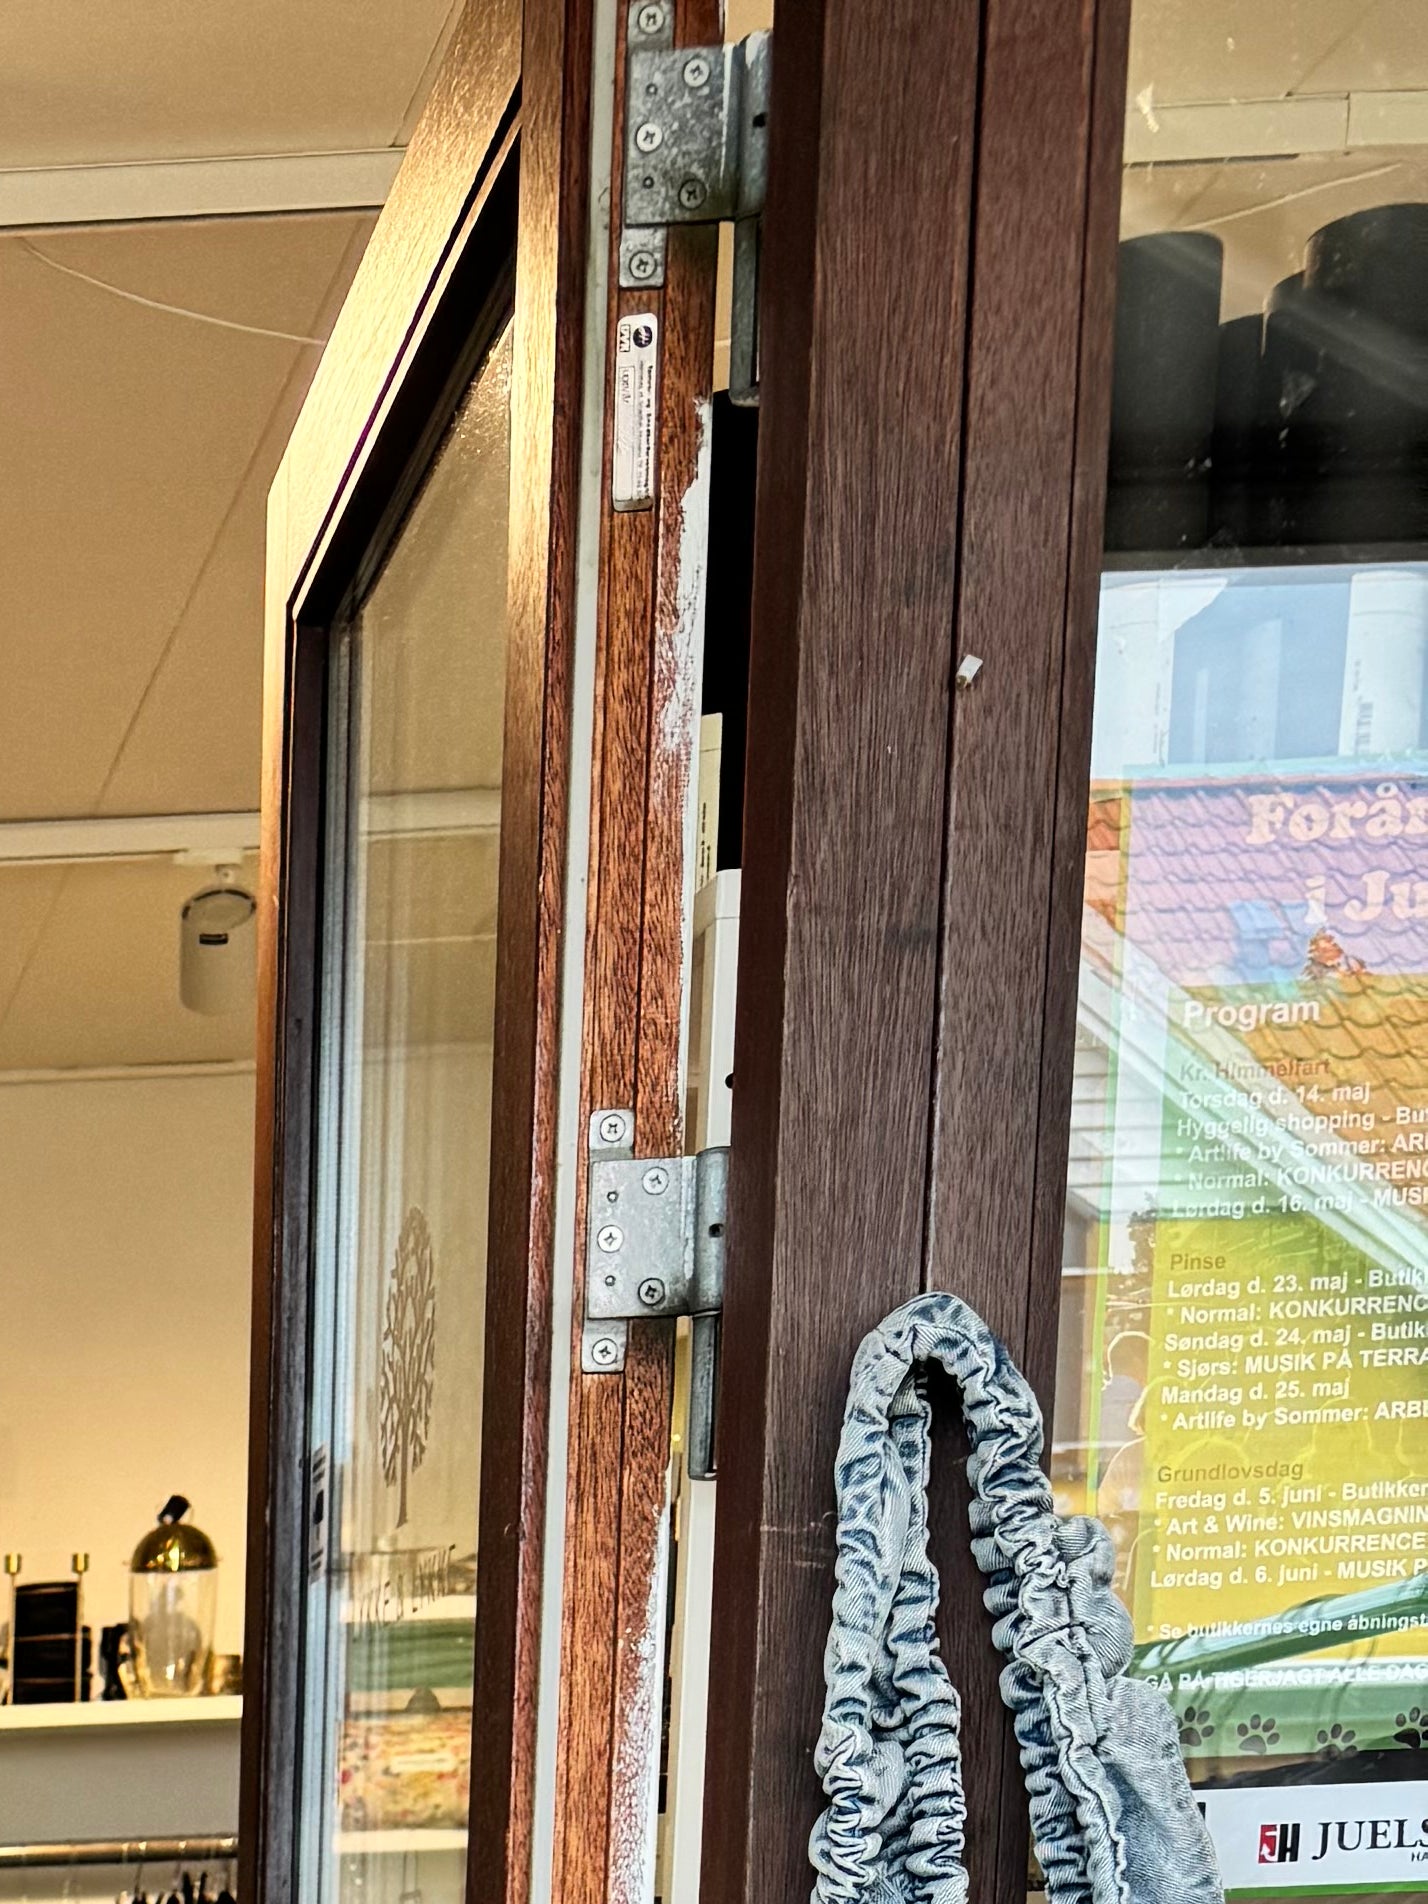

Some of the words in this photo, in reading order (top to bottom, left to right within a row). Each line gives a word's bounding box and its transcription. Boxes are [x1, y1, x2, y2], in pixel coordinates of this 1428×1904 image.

[1183, 1000, 1321, 1031] Program
[1215, 1058, 1331, 1080] Himmelfart
[1178, 1088, 1262, 1110] Torsdag
[1268, 1085, 1288, 1104] d.
[1296, 1085, 1325, 1104] 14.
[1332, 1082, 1370, 1104] maj
[1176, 1114, 1268, 1139] Hyggelig
[1275, 1110, 1375, 1134] shopping
[1257, 1142, 1284, 1164] by
[1290, 1138, 1386, 1158] Sommer:
[1188, 1170, 1269, 1191] Normal:
[1172, 1198, 1245, 1220] Lørdag
[1314, 1191, 1354, 1214] maj
[1170, 1252, 1226, 1271] Pinse
[1168, 1278, 1240, 1299] Lørdag
[1247, 1275, 1265, 1295] d.
[1272, 1275, 1304, 1294] 23.
[1310, 1271, 1348, 1294] maj
[1180, 1305, 1262, 1325] Normal:
[1164, 1332, 1244, 1353] Søndag
[1249, 1329, 1269, 1348] d.
[1275, 1328, 1307, 1347] 24.
[1313, 1324, 1351, 1347] maj
[1176, 1357, 1238, 1380] Sjørs:
[1244, 1353, 1315, 1375] MUSIK
[1322, 1347, 1353, 1370] PÅ
[1161, 1385, 1243, 1406] Mandag
[1249, 1382, 1268, 1401] d.
[1275, 1381, 1305, 1400] 25.
[1312, 1377, 1350, 1400] maj
[1242, 1408, 1268, 1431] by
[1274, 1404, 1369, 1427] Sommer:
[1157, 1461, 1304, 1483] Grundlovsdag
[1155, 1490, 1226, 1511] Fredag
[1232, 1487, 1251, 1506] d.
[1258, 1486, 1276, 1505] 5.
[1281, 1484, 1322, 1506] juni
[1166, 1516, 1198, 1535] Art
[1204, 1515, 1219, 1533] &
[1226, 1511, 1284, 1532] Wine:
[1166, 1542, 1247, 1562] Normal:
[1254, 1532, 1425, 1557] KONKURRENCE
[1150, 1569, 1223, 1589] Lørdag
[1229, 1566, 1248, 1585] d.
[1255, 1565, 1272, 1583] 6.
[1277, 1563, 1318, 1586] juni
[1337, 1559, 1407, 1579] MUSIK
[1159, 1622, 1183, 1640] Se
[1188, 1618, 1295, 1640] butikkernes
[1298, 1615, 1342, 1636] egne
[1145, 1670, 1173, 1691] GÅ
